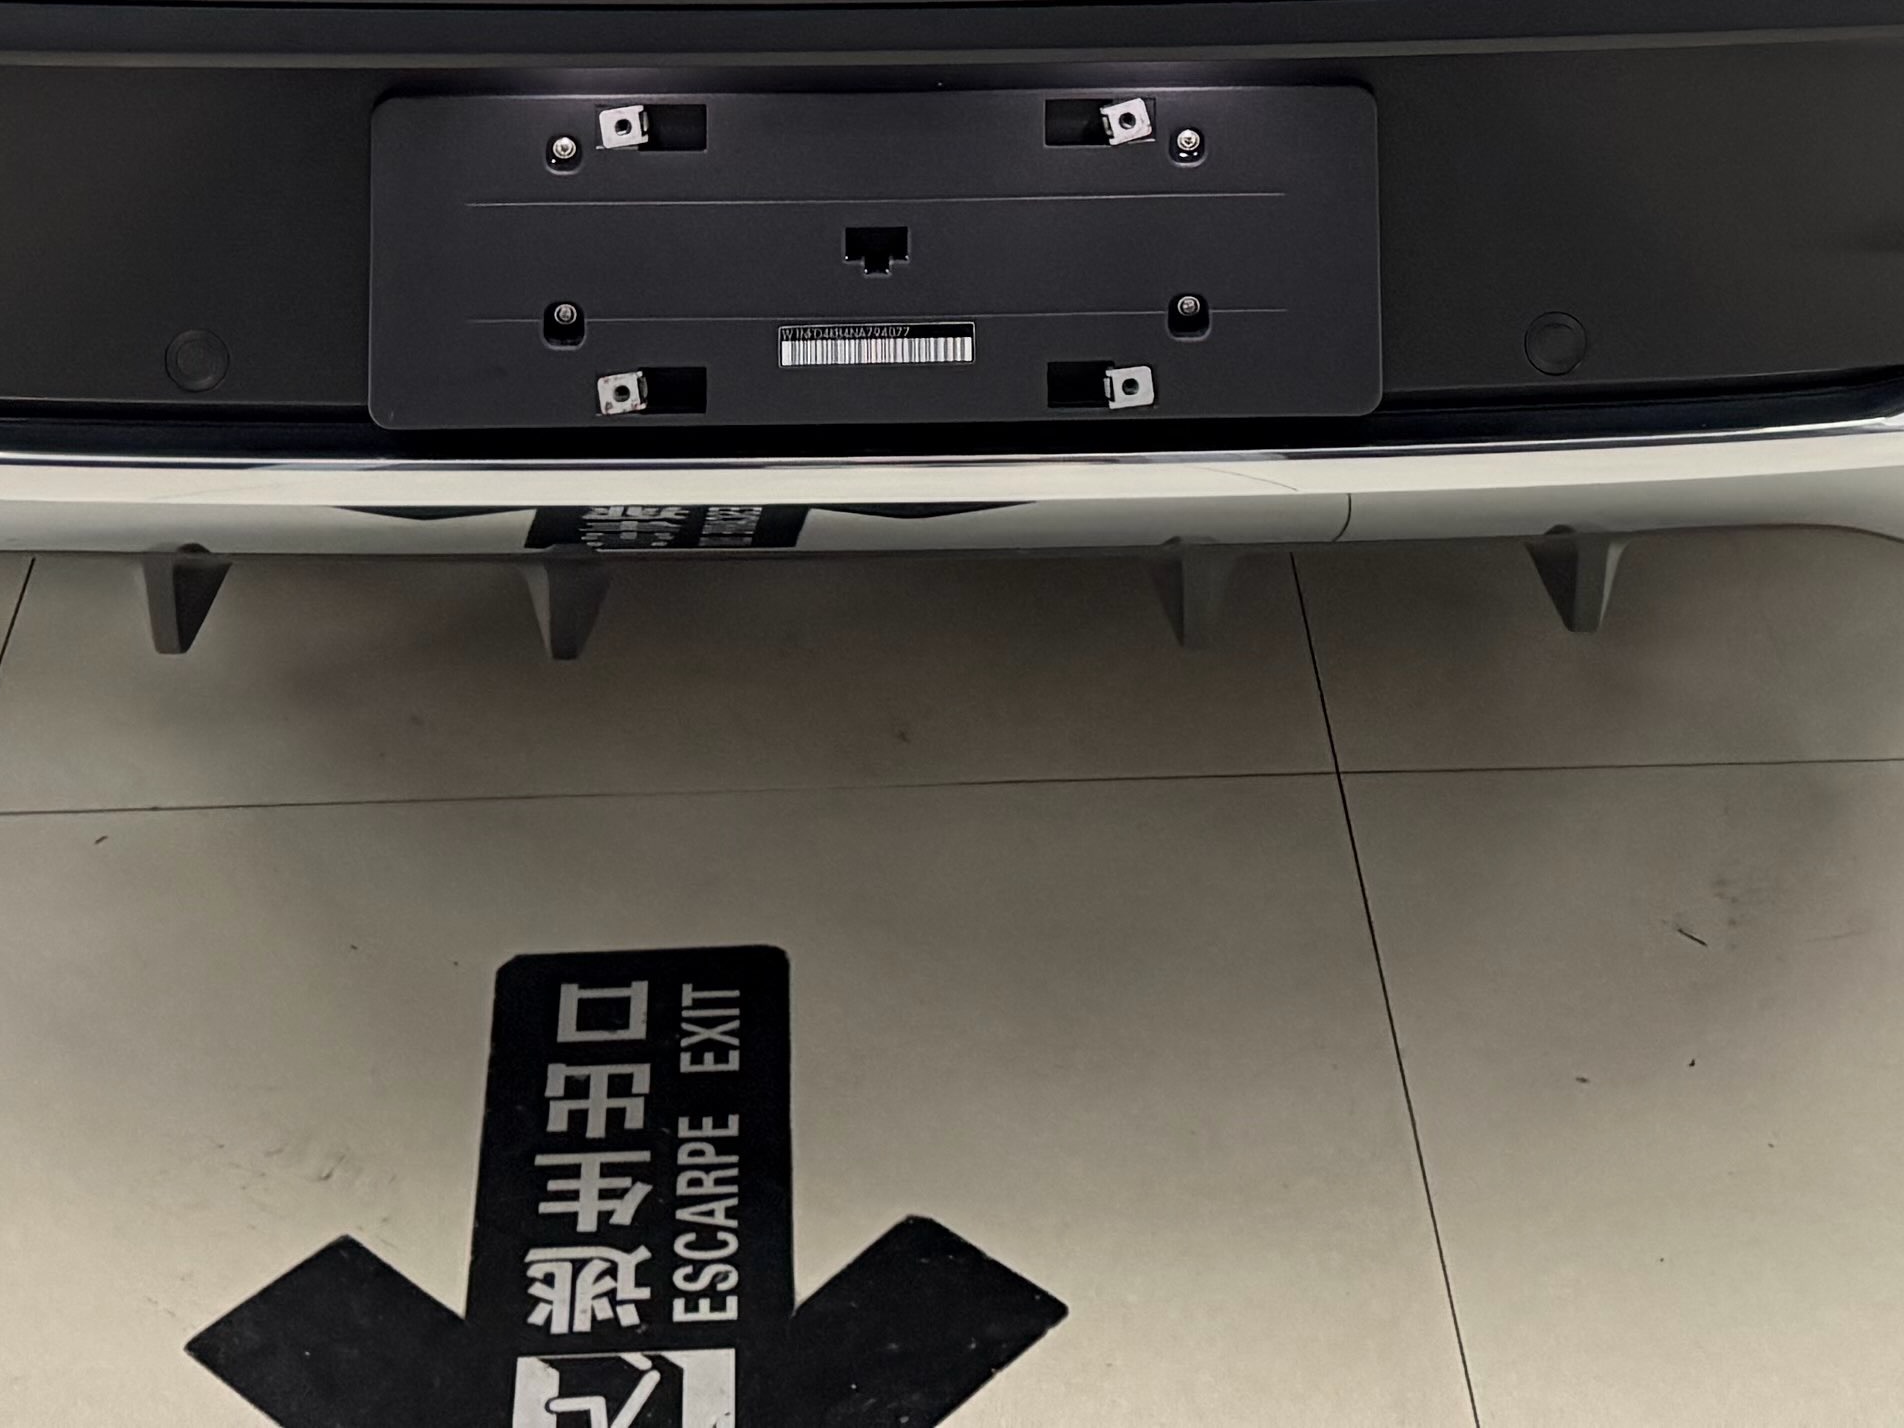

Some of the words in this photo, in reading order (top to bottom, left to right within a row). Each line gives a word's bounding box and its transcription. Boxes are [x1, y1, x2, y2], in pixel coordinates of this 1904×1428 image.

[679, 982, 741, 1074] EXIT
[526, 980, 654, 1336] 逃生出口
[671, 1112, 741, 1326] ESCARPE
